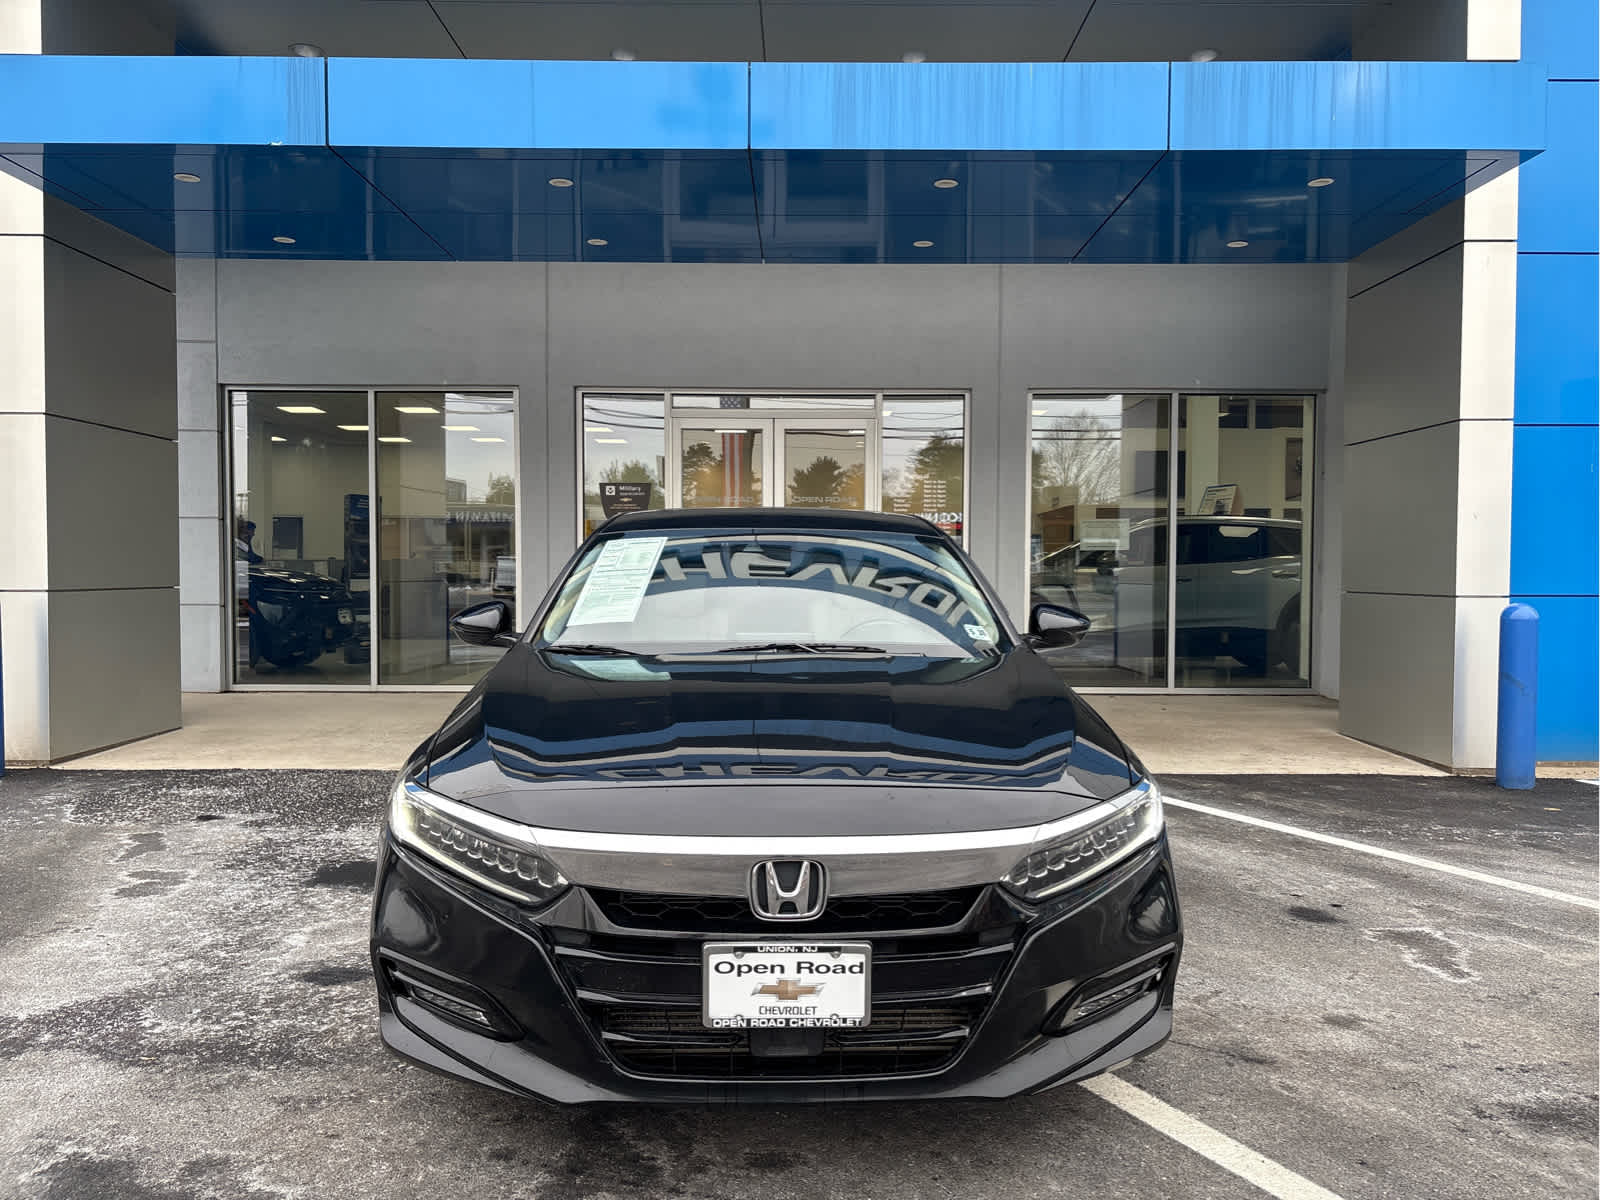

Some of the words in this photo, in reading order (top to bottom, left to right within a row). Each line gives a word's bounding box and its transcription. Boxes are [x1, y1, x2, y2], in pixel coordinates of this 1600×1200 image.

[714, 961, 785, 977] Open
[796, 961, 865, 975] Road
[758, 1006, 818, 1016] CHEVROLET
[712, 1018, 747, 1028] OPEN
[750, 1018, 786, 1028] ROAD
[789, 1018, 862, 1027] CHEVROLET
